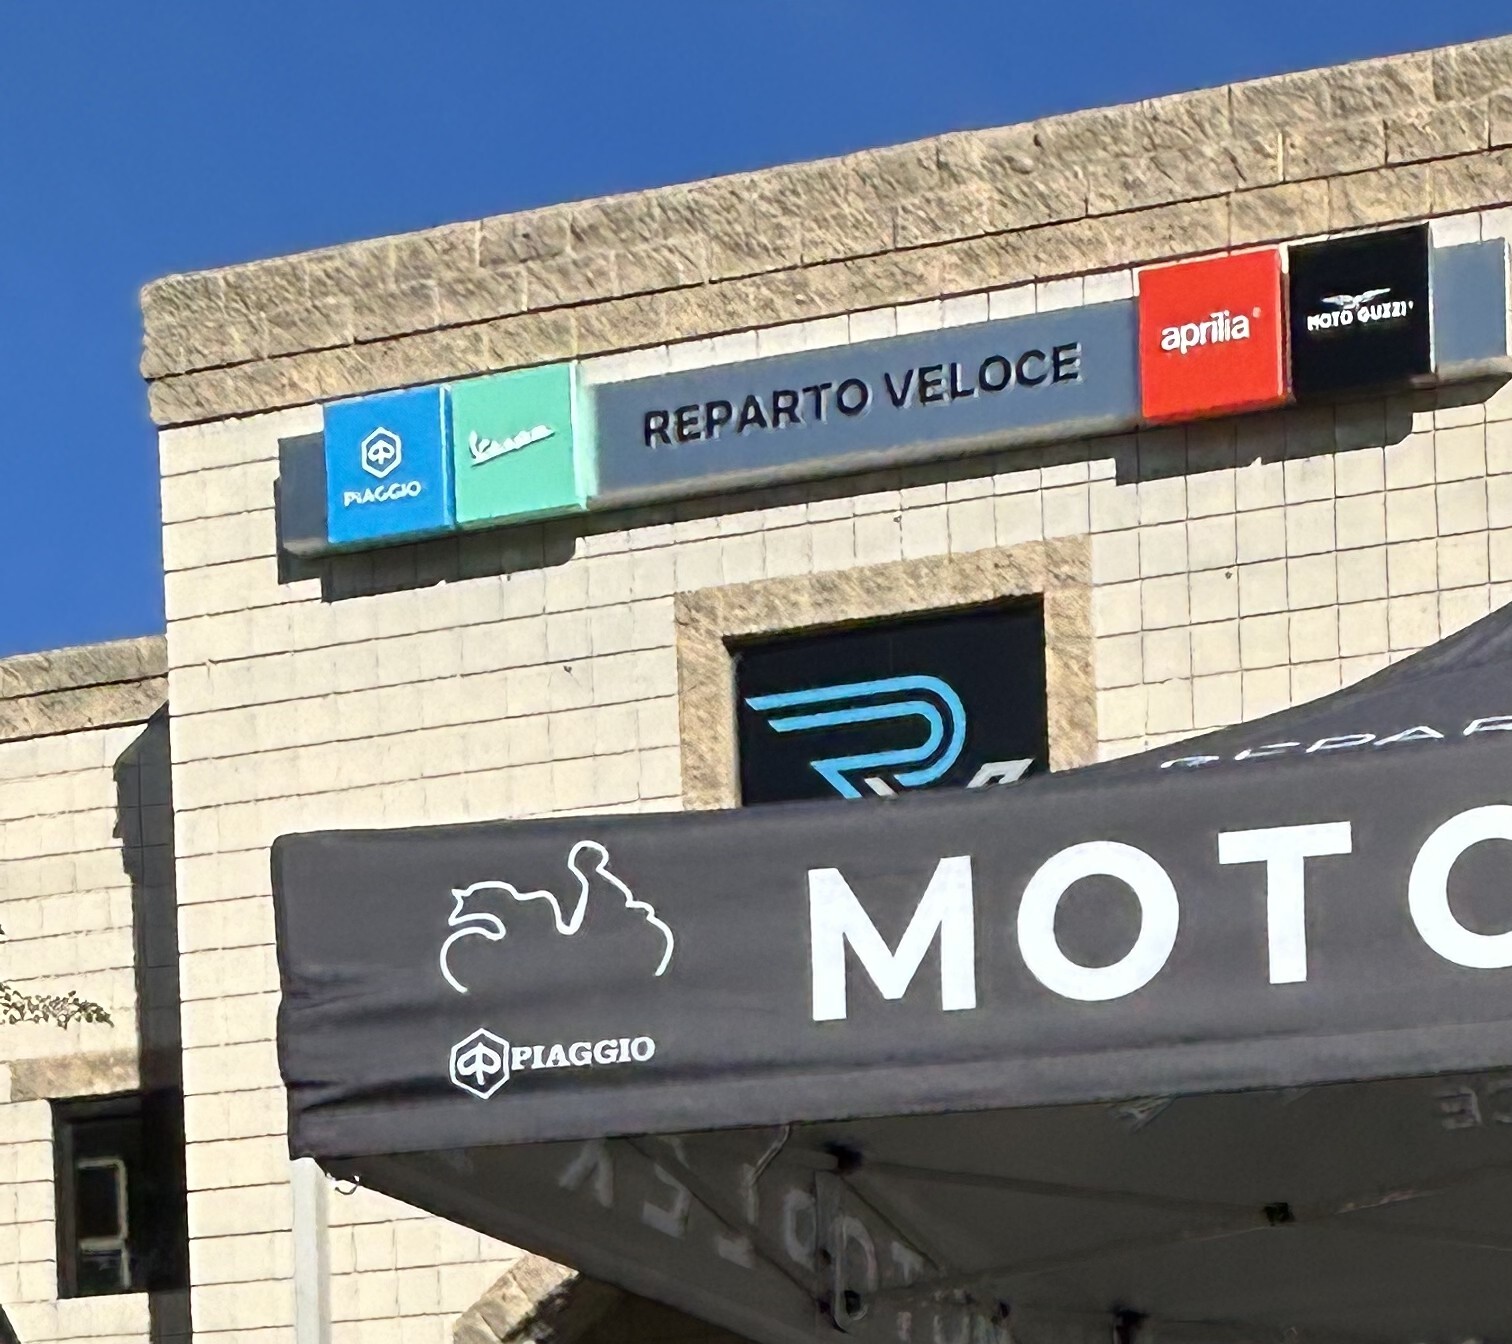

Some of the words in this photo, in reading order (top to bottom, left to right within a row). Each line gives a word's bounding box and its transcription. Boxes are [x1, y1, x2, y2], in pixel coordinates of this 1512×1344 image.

[1160, 310, 1251, 355] aprilia
[1307, 309, 1354, 332] MOTO
[1356, 300, 1407, 323] GUZZI
[643, 377, 869, 448] REPARTO
[884, 341, 1082, 410] VELOCE
[343, 480, 422, 508] PIAGGIO
[510, 1034, 656, 1074] PIAGGIO
